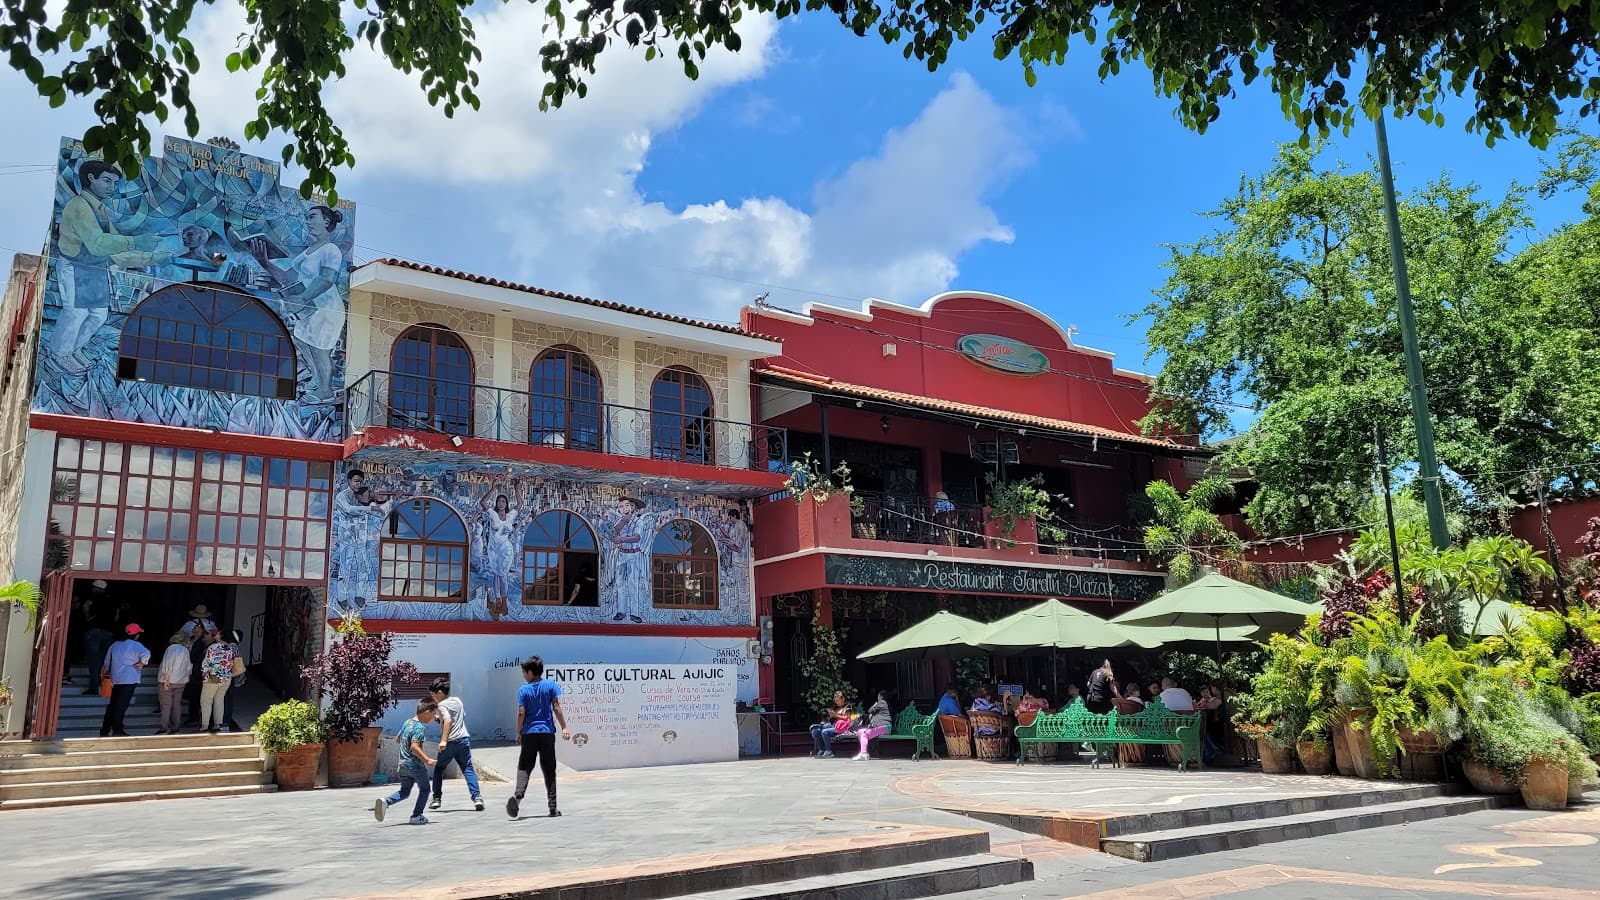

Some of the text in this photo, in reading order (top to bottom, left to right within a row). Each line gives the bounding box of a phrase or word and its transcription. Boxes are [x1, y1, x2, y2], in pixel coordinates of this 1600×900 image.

[192, 157, 209, 170] DE
[456, 472, 492, 485] DANZA
[597, 485, 628, 498] TEATRO
[700, 496, 733, 508] PINTURA
[921, 563, 1005, 590] Restaurant
[1064, 572, 1108, 597] Plaza
[545, 668, 595, 682] ENTRO
[604, 667, 676, 682] CULTURAL
[683, 668, 725, 680] AJIJIC
[578, 683, 625, 695] SABATINOS
